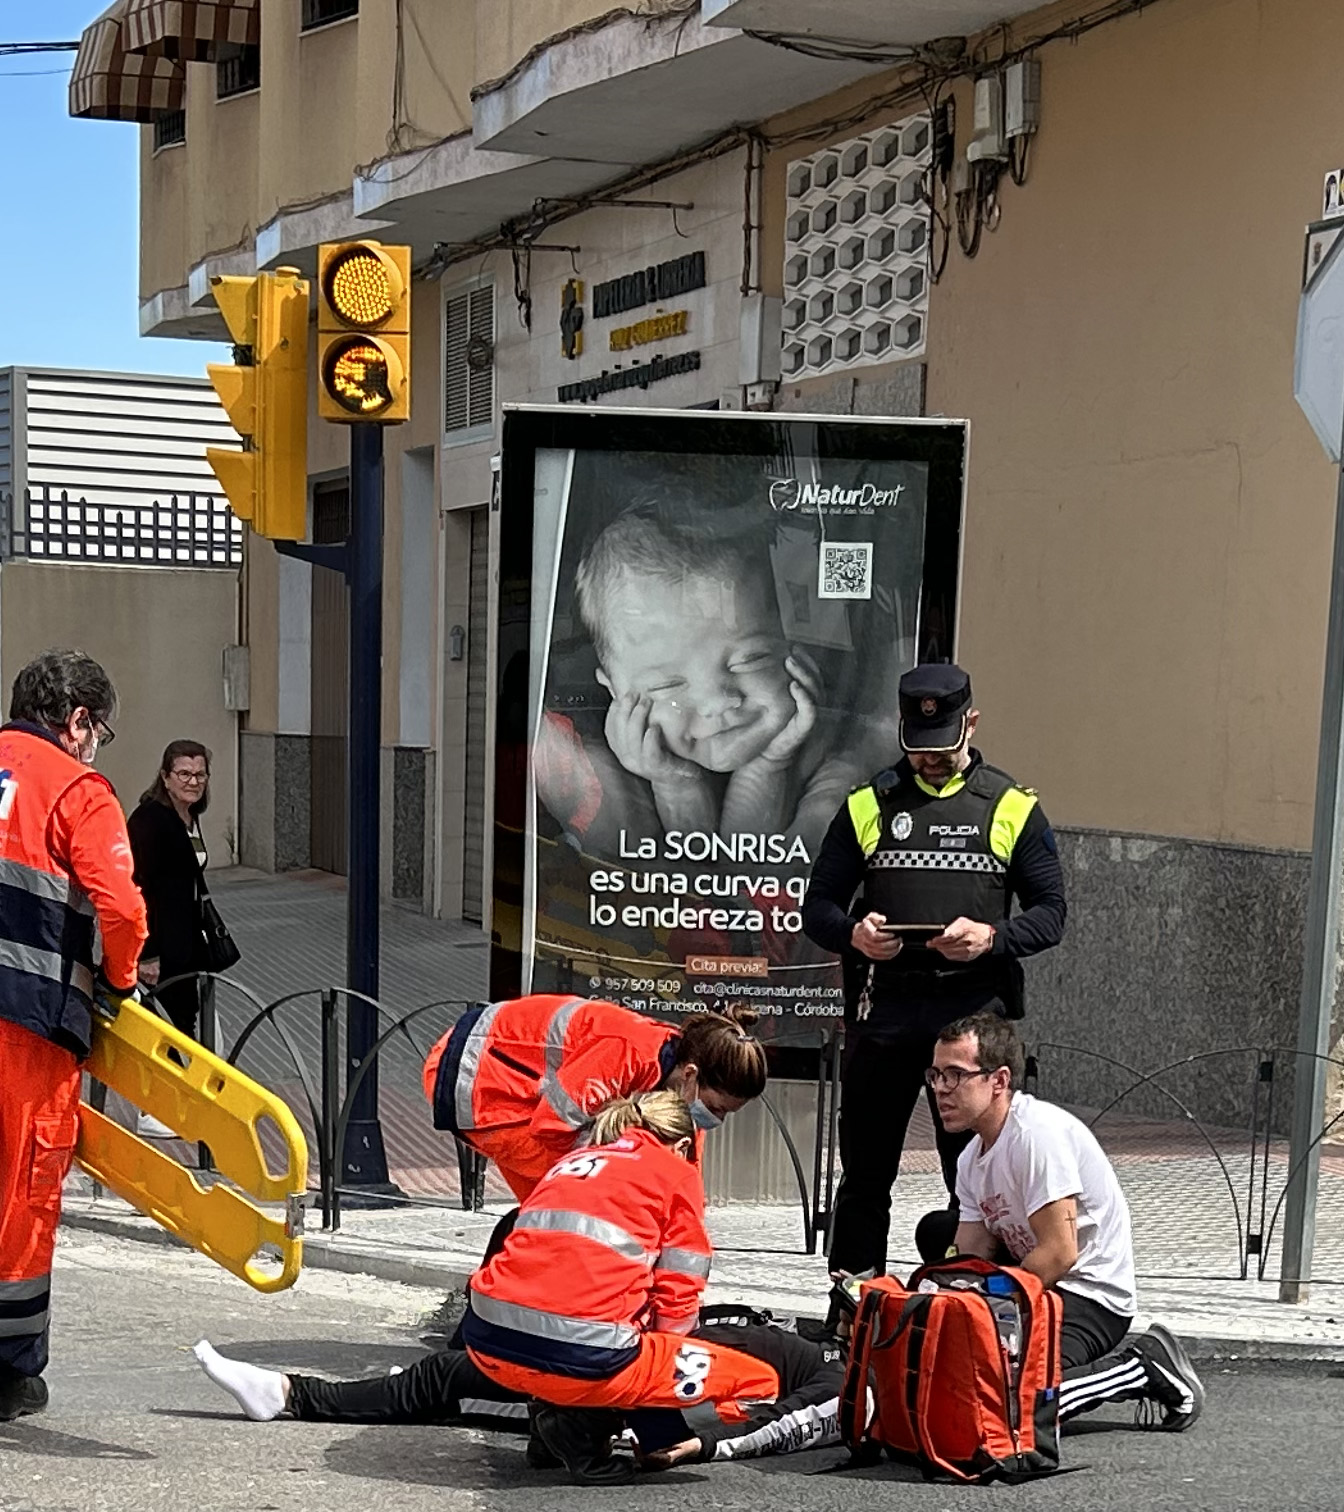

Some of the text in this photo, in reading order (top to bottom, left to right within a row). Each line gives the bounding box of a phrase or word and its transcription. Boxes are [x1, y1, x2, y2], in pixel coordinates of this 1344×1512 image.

[802, 483, 906, 507] NaturDent
[619, 829, 811, 864] La SONRISA
[589, 870, 625, 892] es
[631, 872, 688, 894] una
[695, 874, 780, 898] curva
[589, 895, 616, 925] lo
[622, 897, 764, 931] endereza
[690, 958, 763, 974] Cita previa:
[606, 978, 628, 992] 957
[630, 980, 654, 993] 509
[657, 980, 681, 993] 509
[622, 996, 646, 1010] San
